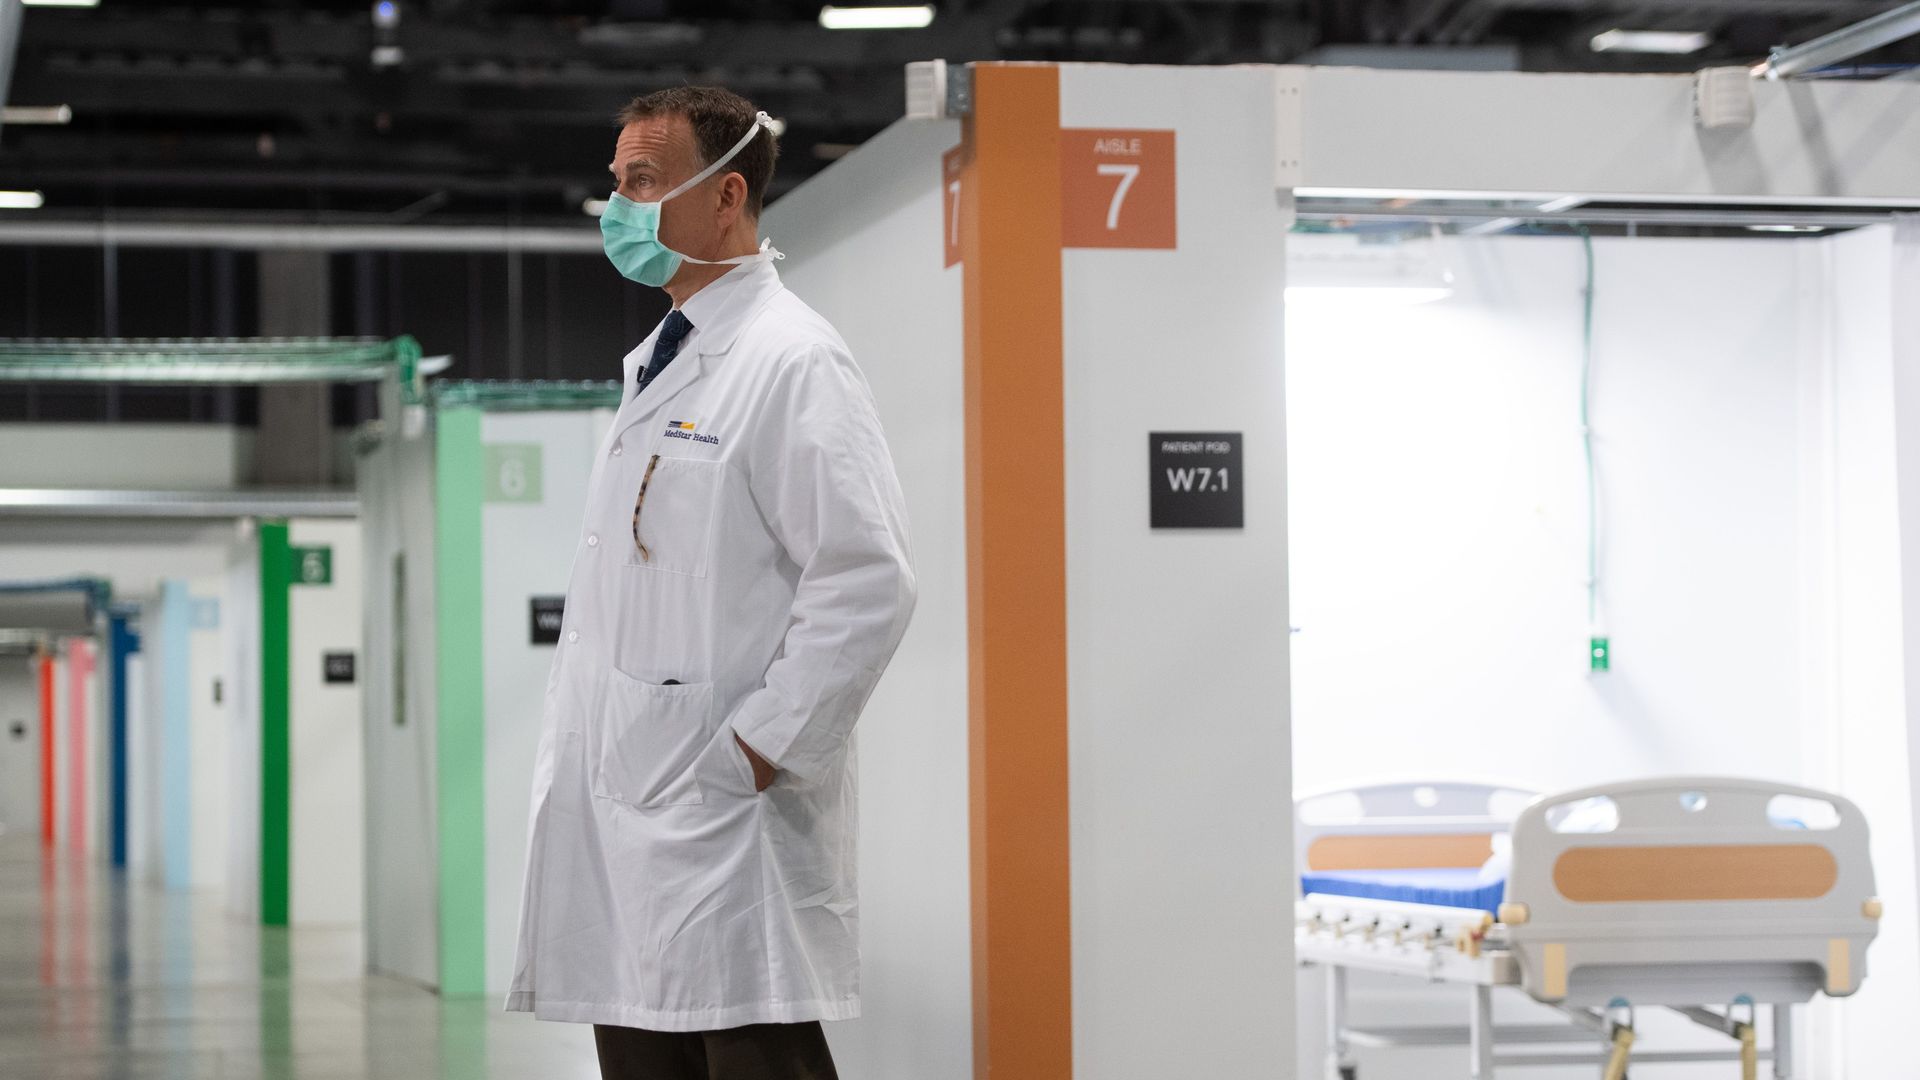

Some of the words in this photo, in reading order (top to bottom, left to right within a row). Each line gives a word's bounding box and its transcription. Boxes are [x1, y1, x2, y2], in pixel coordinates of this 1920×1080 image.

[1093, 138, 1141, 155] AISLE
[1096, 164, 1140, 230] 7
[664, 430, 692, 440] MedStar
[693, 433, 719, 445] Health
[1161, 441, 1204, 454] PATIENT
[1205, 441, 1231, 454] POD
[500, 458, 526, 498] 6
[1166, 466, 1229, 493] W7.1
